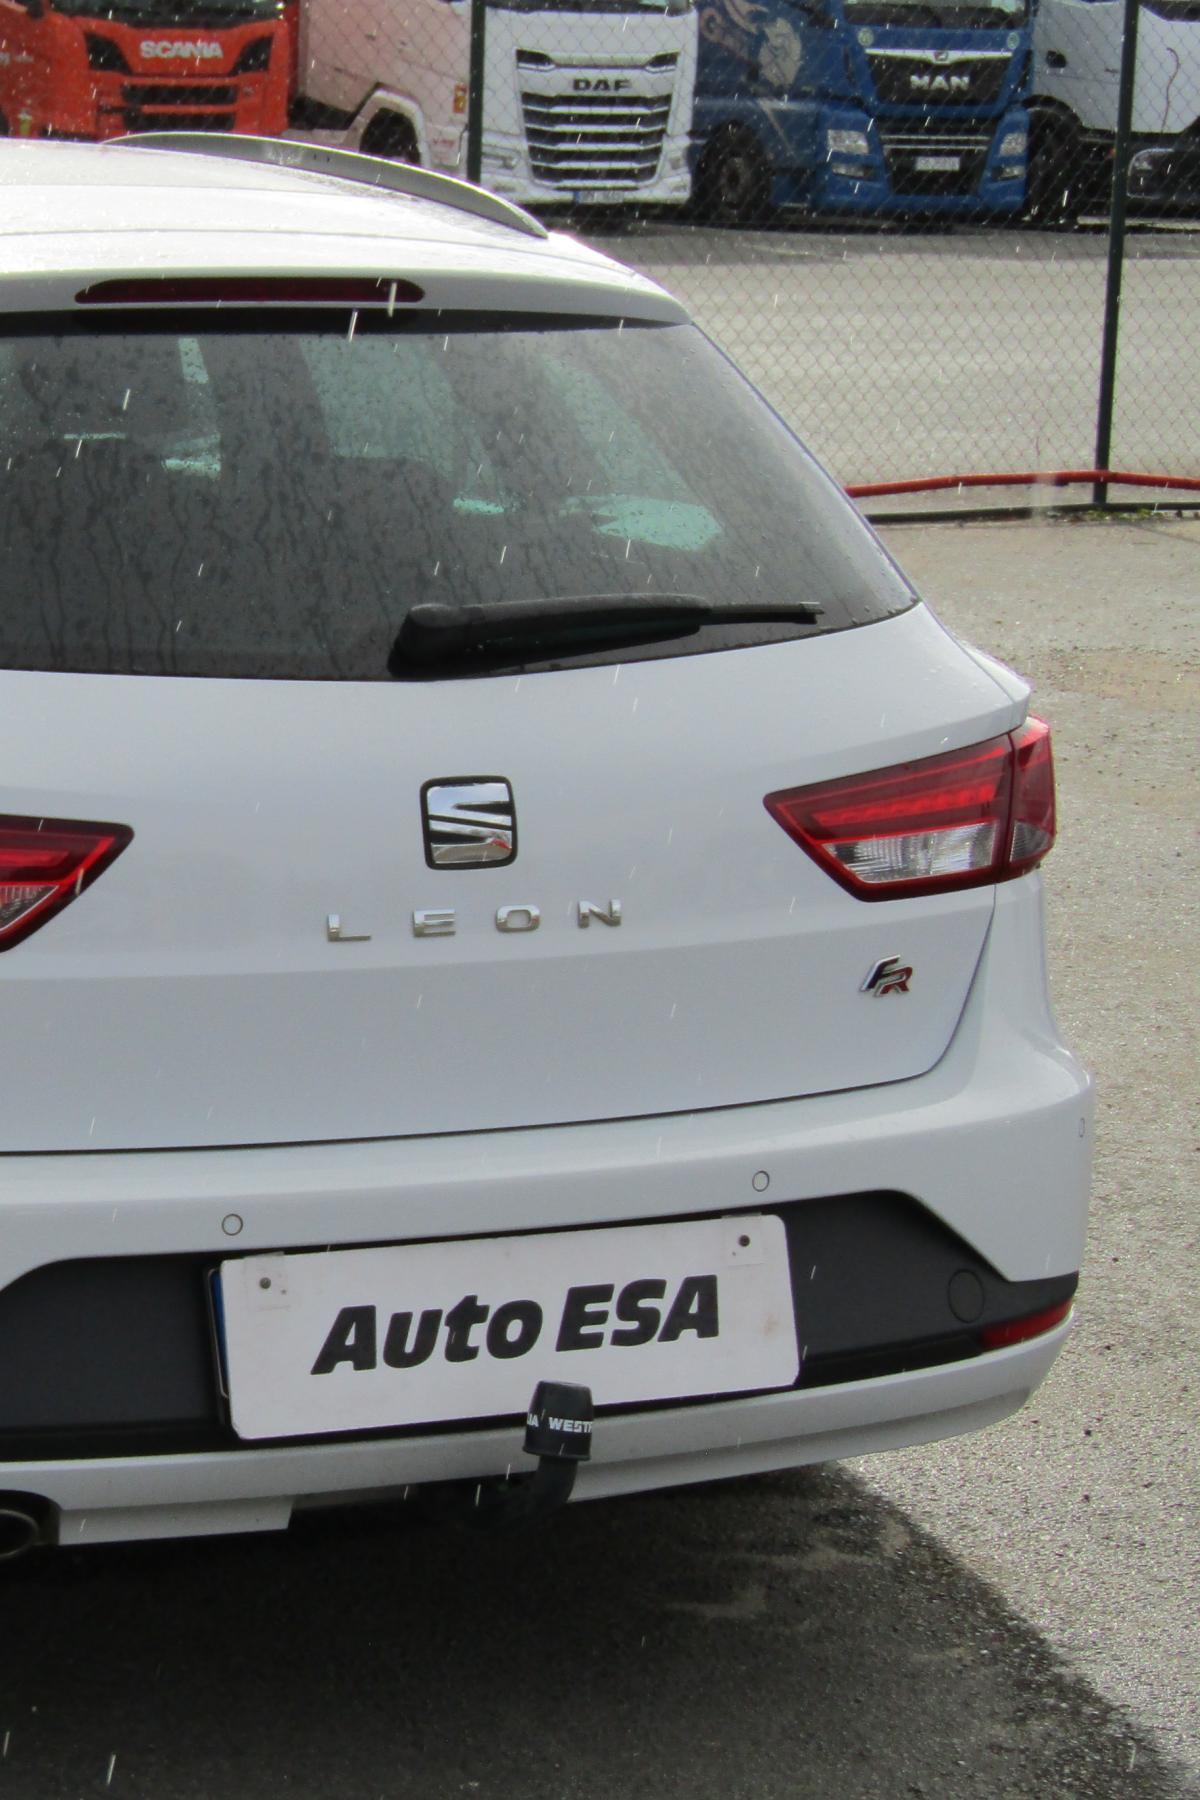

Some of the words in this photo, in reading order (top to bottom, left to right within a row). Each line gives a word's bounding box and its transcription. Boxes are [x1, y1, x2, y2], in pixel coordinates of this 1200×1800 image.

[140, 40, 224, 59] SCANIA
[573, 79, 632, 91] DAF
[910, 75, 970, 91] MAN
[327, 899, 622, 943] LEON
[859, 954, 913, 998] FR
[310, 1294, 544, 1376] Auto
[555, 1274, 720, 1352] ESA
